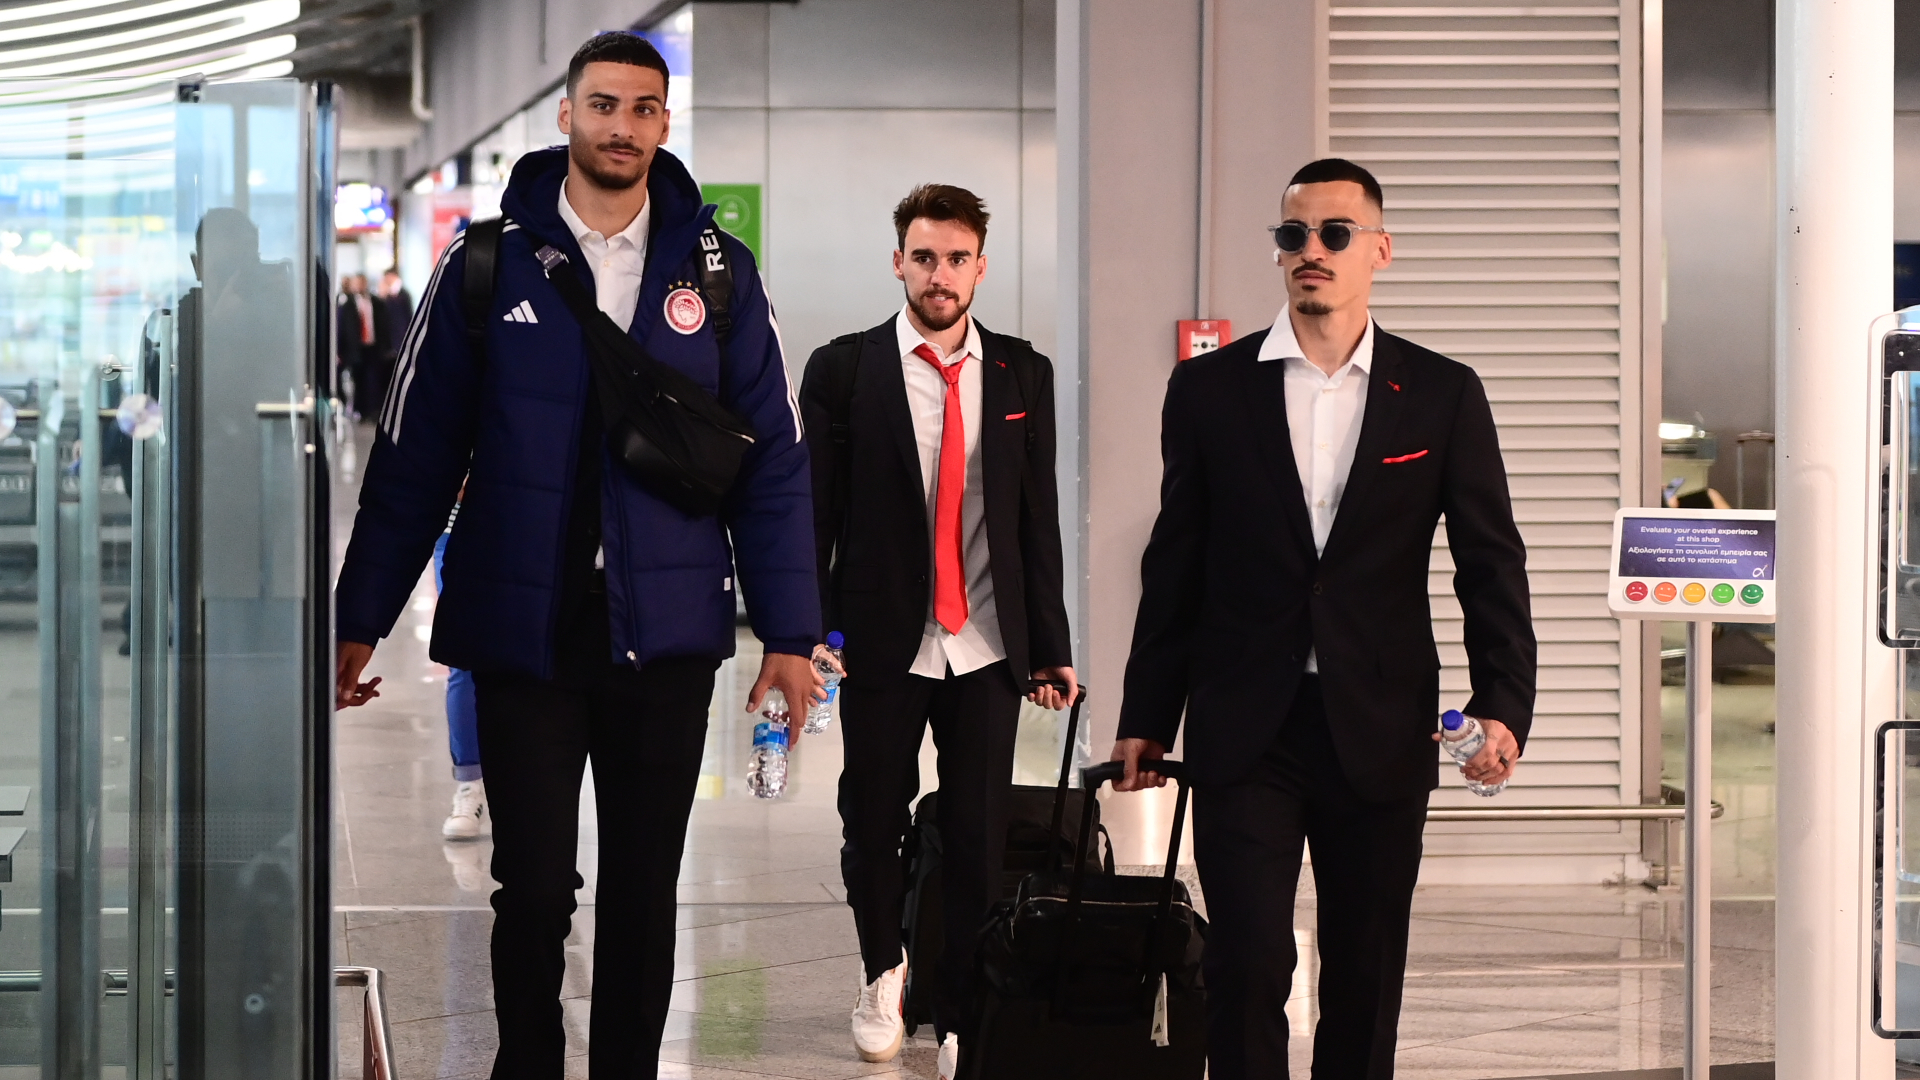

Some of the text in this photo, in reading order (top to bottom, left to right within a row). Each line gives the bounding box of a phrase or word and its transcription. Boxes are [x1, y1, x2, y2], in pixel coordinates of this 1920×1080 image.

[699, 228, 725, 272] RE
[1717, 528, 1759, 536] experience
[1628, 546, 1674, 555] Αξιολογήστε
[1720, 549, 1752, 557] εμπειρία
